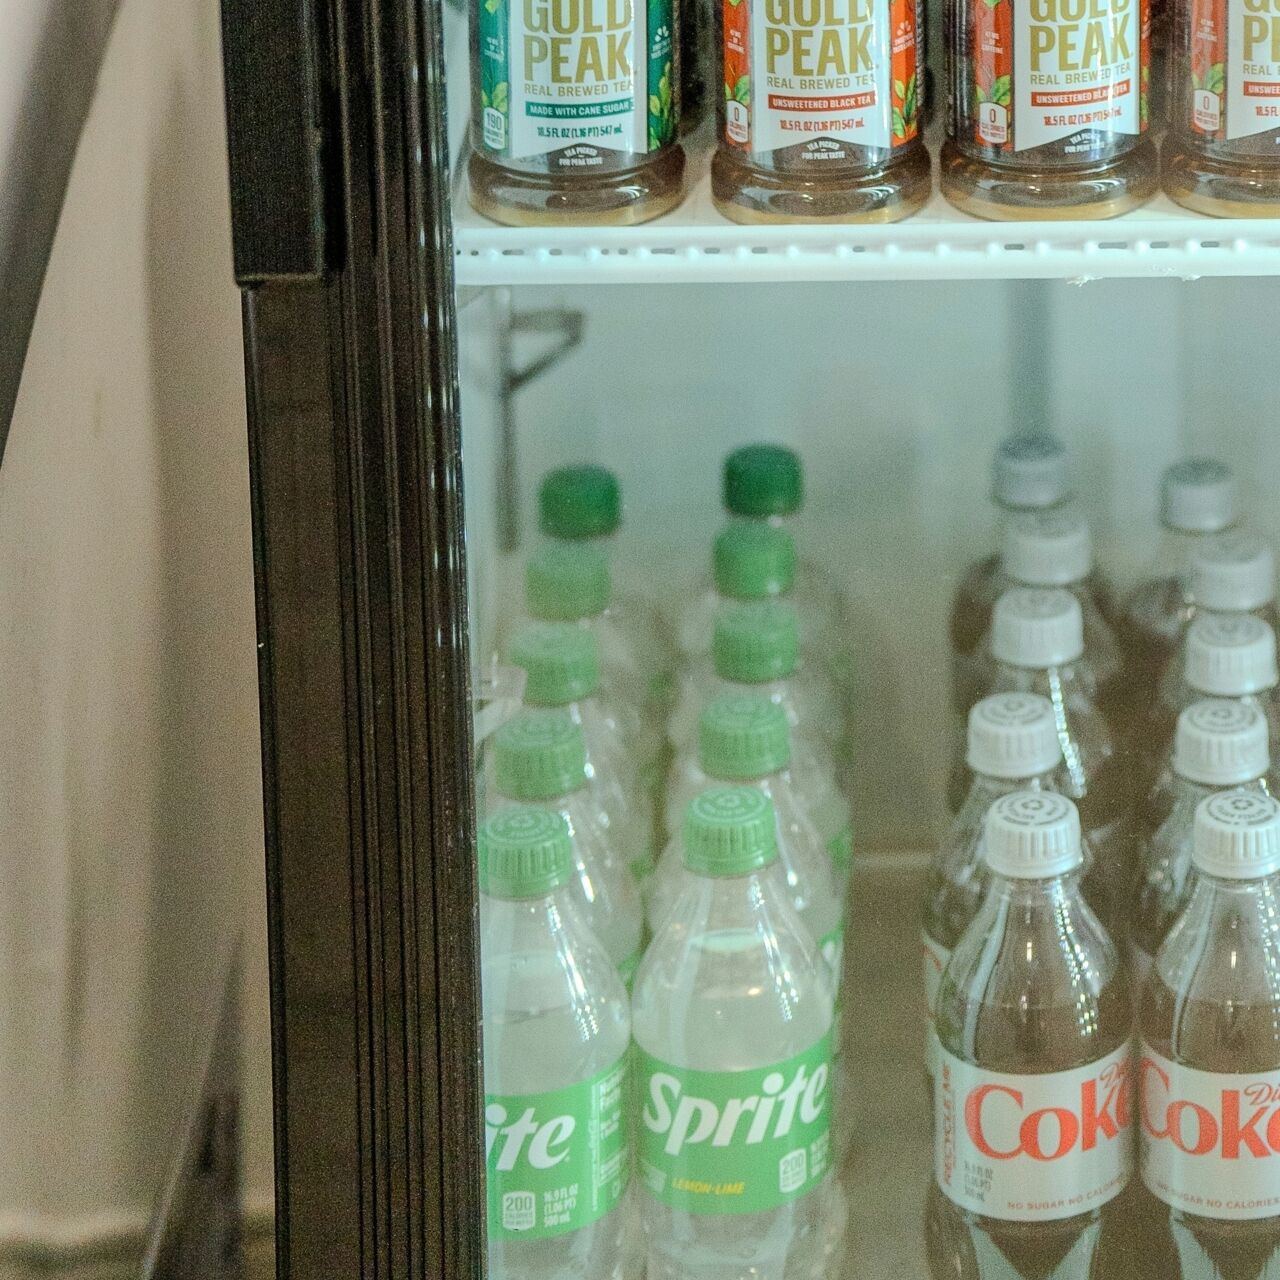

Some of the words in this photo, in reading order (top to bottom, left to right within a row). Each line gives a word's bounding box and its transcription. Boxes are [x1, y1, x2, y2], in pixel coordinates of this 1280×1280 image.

[1029, 13, 1132, 72] PEAK
[523, 31, 635, 84] PEAK
[765, 24, 876, 77] PEAK
[1030, 72, 1060, 85] REAL
[1115, 62, 1131, 76] TEA
[1243, 63, 1272, 76] REAL
[524, 84, 553, 97] REAL
[557, 83, 609, 97] BREWED
[613, 80, 634, 93] TEA
[766, 76, 795, 89] REAL
[800, 75, 851, 90] BREWED
[772, 97, 829, 109] UNSWEETENED
[829, 96, 856, 108] BLACK
[858, 96, 871, 106] TEA
[1036, 93, 1093, 105] UNSWEETENED
[530, 105, 553, 115] MADE
[555, 106, 577, 116] WITH
[578, 105, 601, 116] CANE
[602, 102, 629, 114] SUGAR
[734, 107, 740, 122] 0
[990, 108, 996, 123] 0
[643, 1063, 829, 1156] Sprite
[485, 1103, 576, 1171] ite
[672, 1177, 745, 1195] LEMON-LIME
[505, 1197, 532, 1212] 200
[1206, 1199, 1222, 1209] NO
[1226, 1196, 1280, 1209] CALORIES
